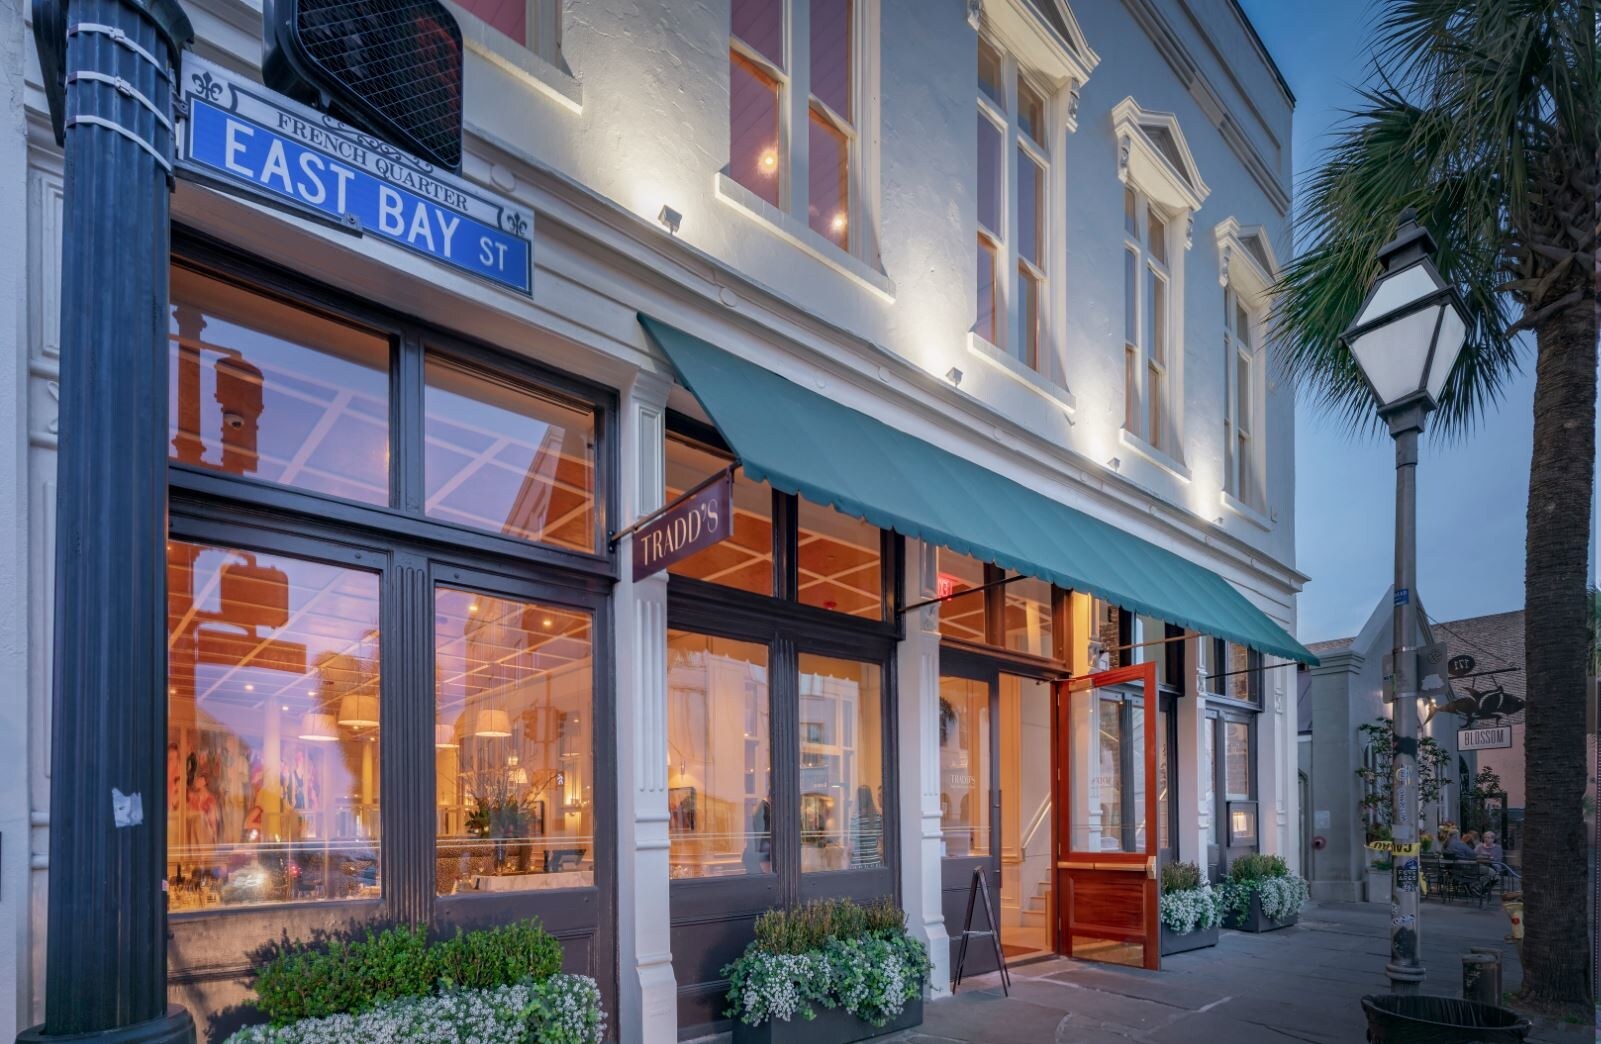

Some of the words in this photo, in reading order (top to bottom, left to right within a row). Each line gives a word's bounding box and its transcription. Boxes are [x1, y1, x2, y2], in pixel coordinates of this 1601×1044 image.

[225, 118, 355, 214] EAST
[378, 184, 460, 257] BAY
[479, 236, 508, 271] ST
[276, 111, 367, 165] FRENCH
[375, 153, 469, 212] QUARTER
[641, 498, 719, 566] TRADD'S
[1464, 729, 1504, 746] BLOSSOM
